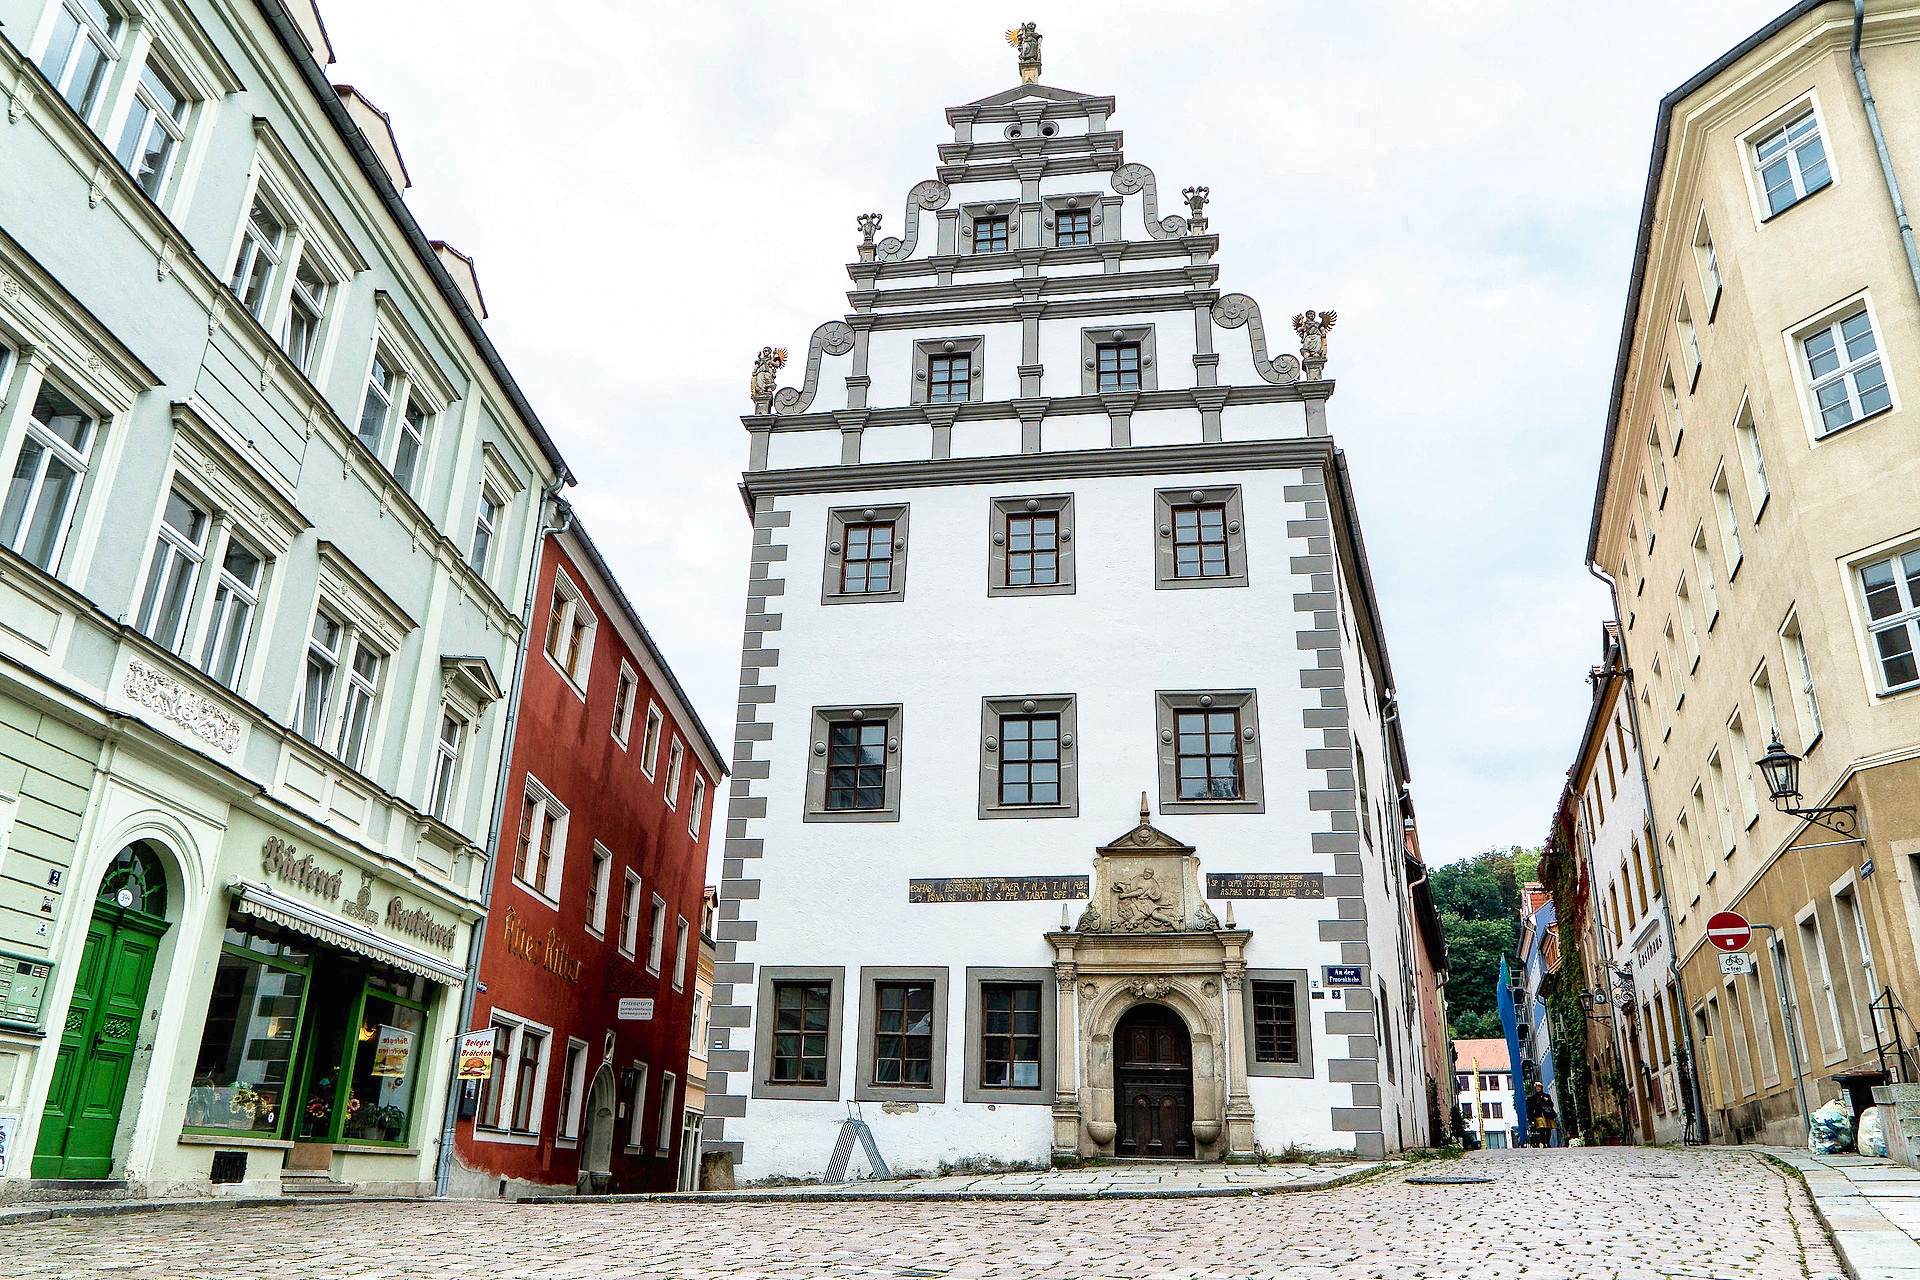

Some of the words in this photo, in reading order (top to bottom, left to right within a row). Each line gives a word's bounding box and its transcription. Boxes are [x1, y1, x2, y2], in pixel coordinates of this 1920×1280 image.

[264, 836, 343, 900] Bäckerei
[385, 896, 457, 950] Konditorei
[543, 927, 582, 984] Ritter
[32, 986, 38, 998] 2
[461, 1049, 492, 1057] Brötchen
[465, 1039, 491, 1048] Belegte
